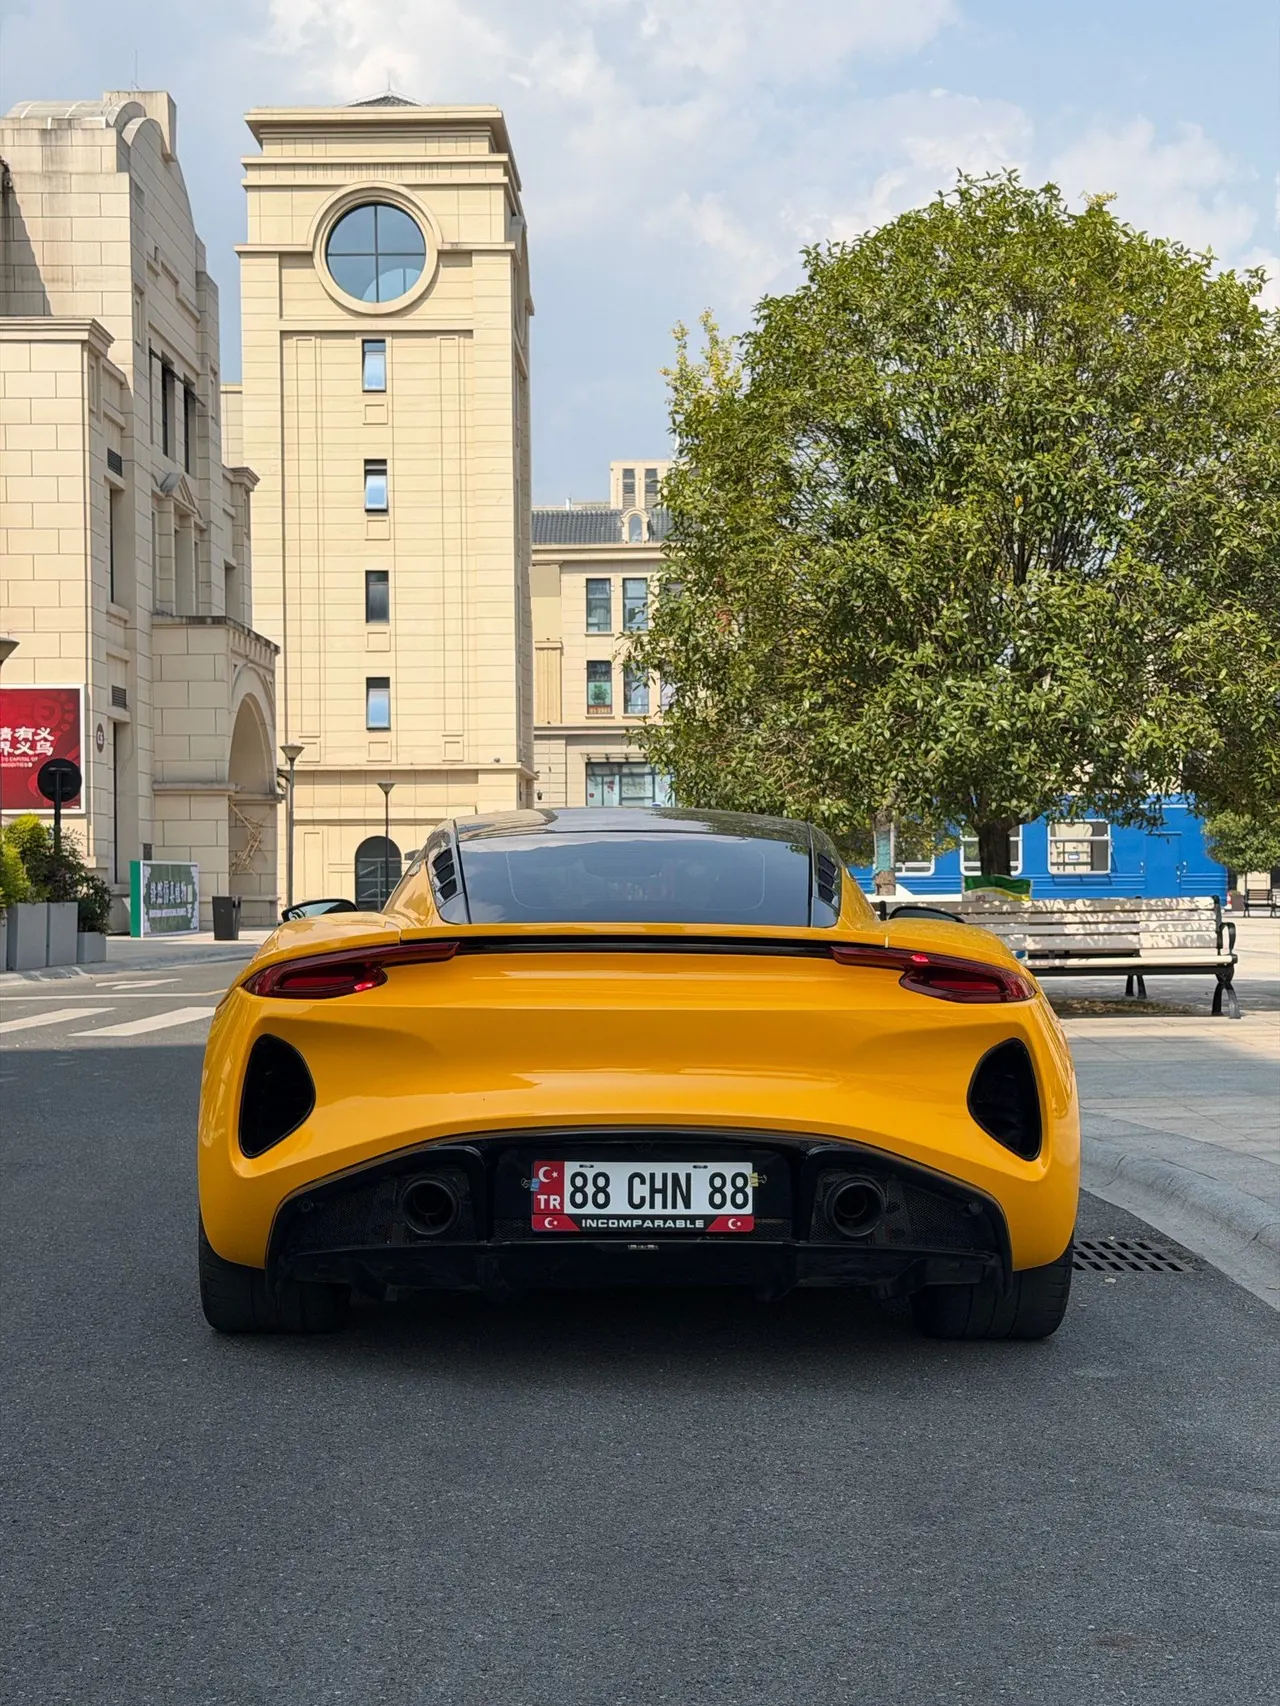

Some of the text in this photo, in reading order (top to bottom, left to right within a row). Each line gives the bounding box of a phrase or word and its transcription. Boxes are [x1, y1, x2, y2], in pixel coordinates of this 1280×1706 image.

[569, 1171, 749, 1210] 88 CHN 88
[537, 1195, 561, 1210] TR
[582, 1219, 705, 1229] INCOMPARABLE
